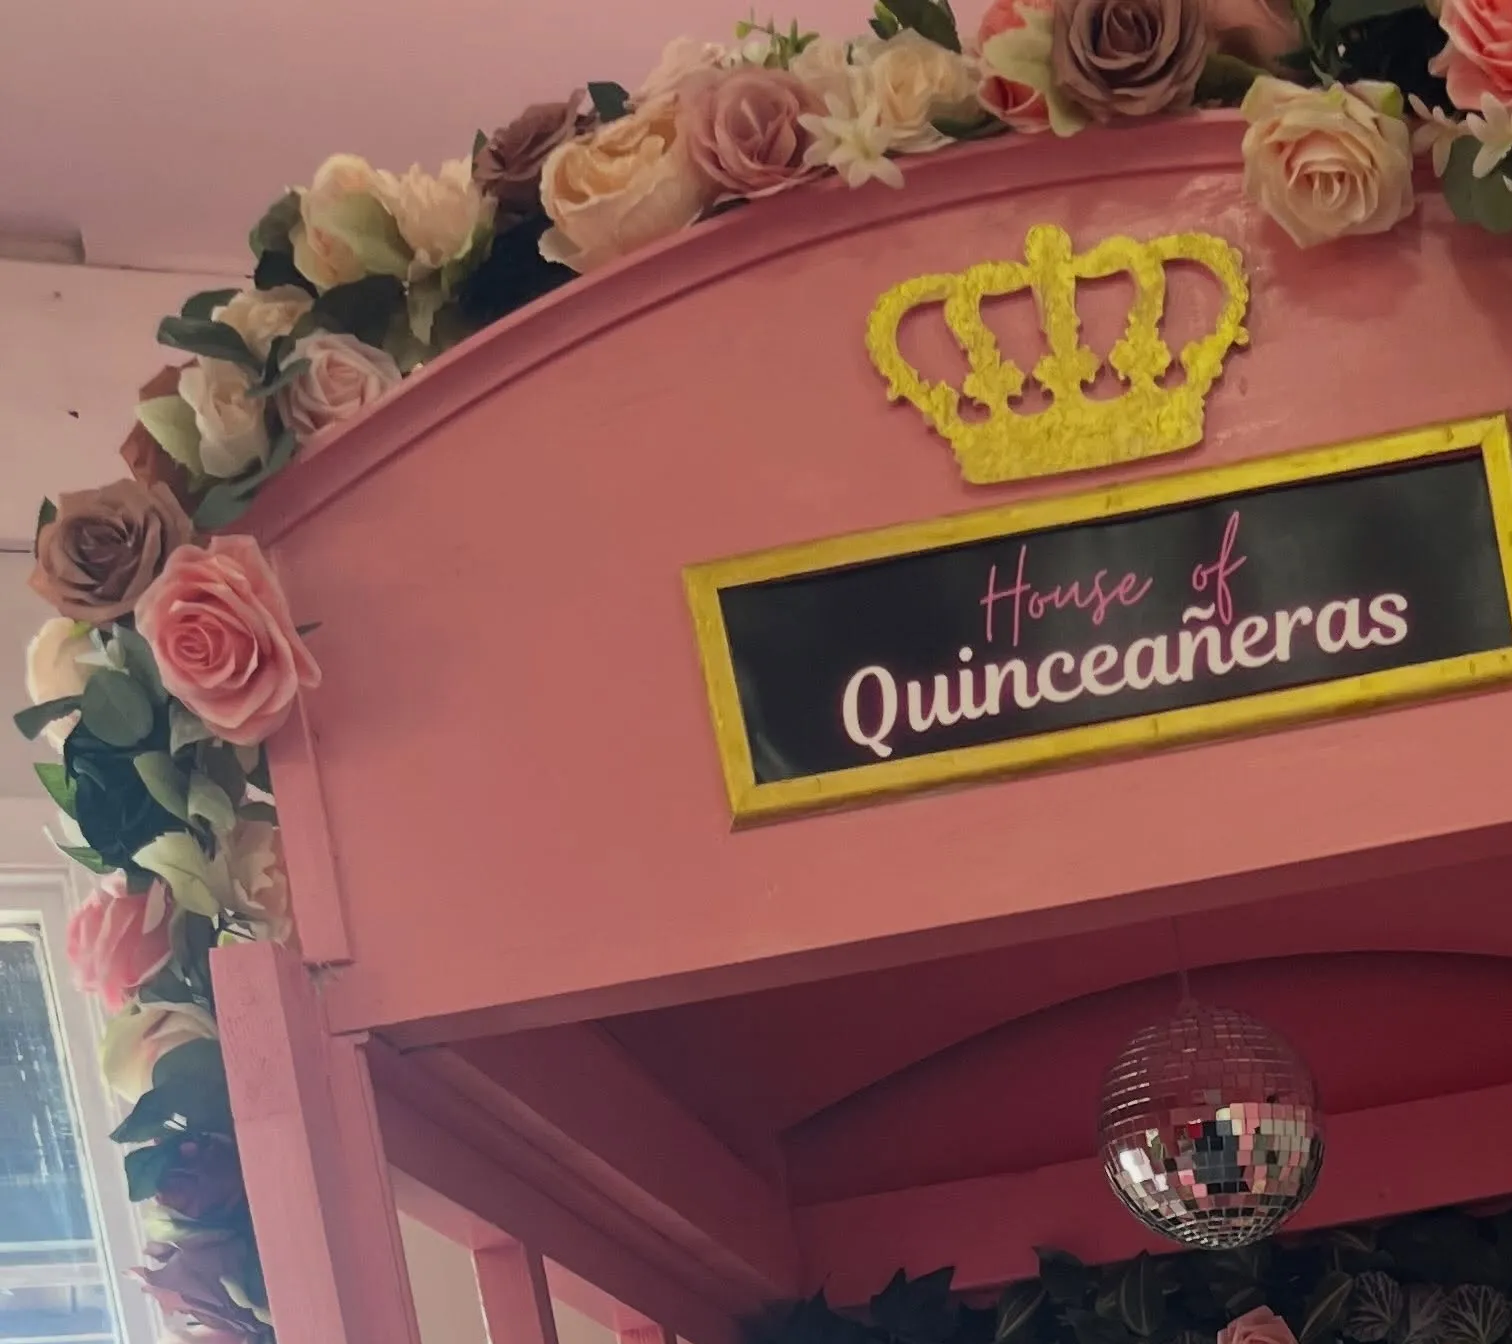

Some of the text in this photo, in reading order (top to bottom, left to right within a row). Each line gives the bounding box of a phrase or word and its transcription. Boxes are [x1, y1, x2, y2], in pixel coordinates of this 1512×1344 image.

[980, 510, 1248, 646] House of
[841, 592, 1409, 758] Quinceañeras
